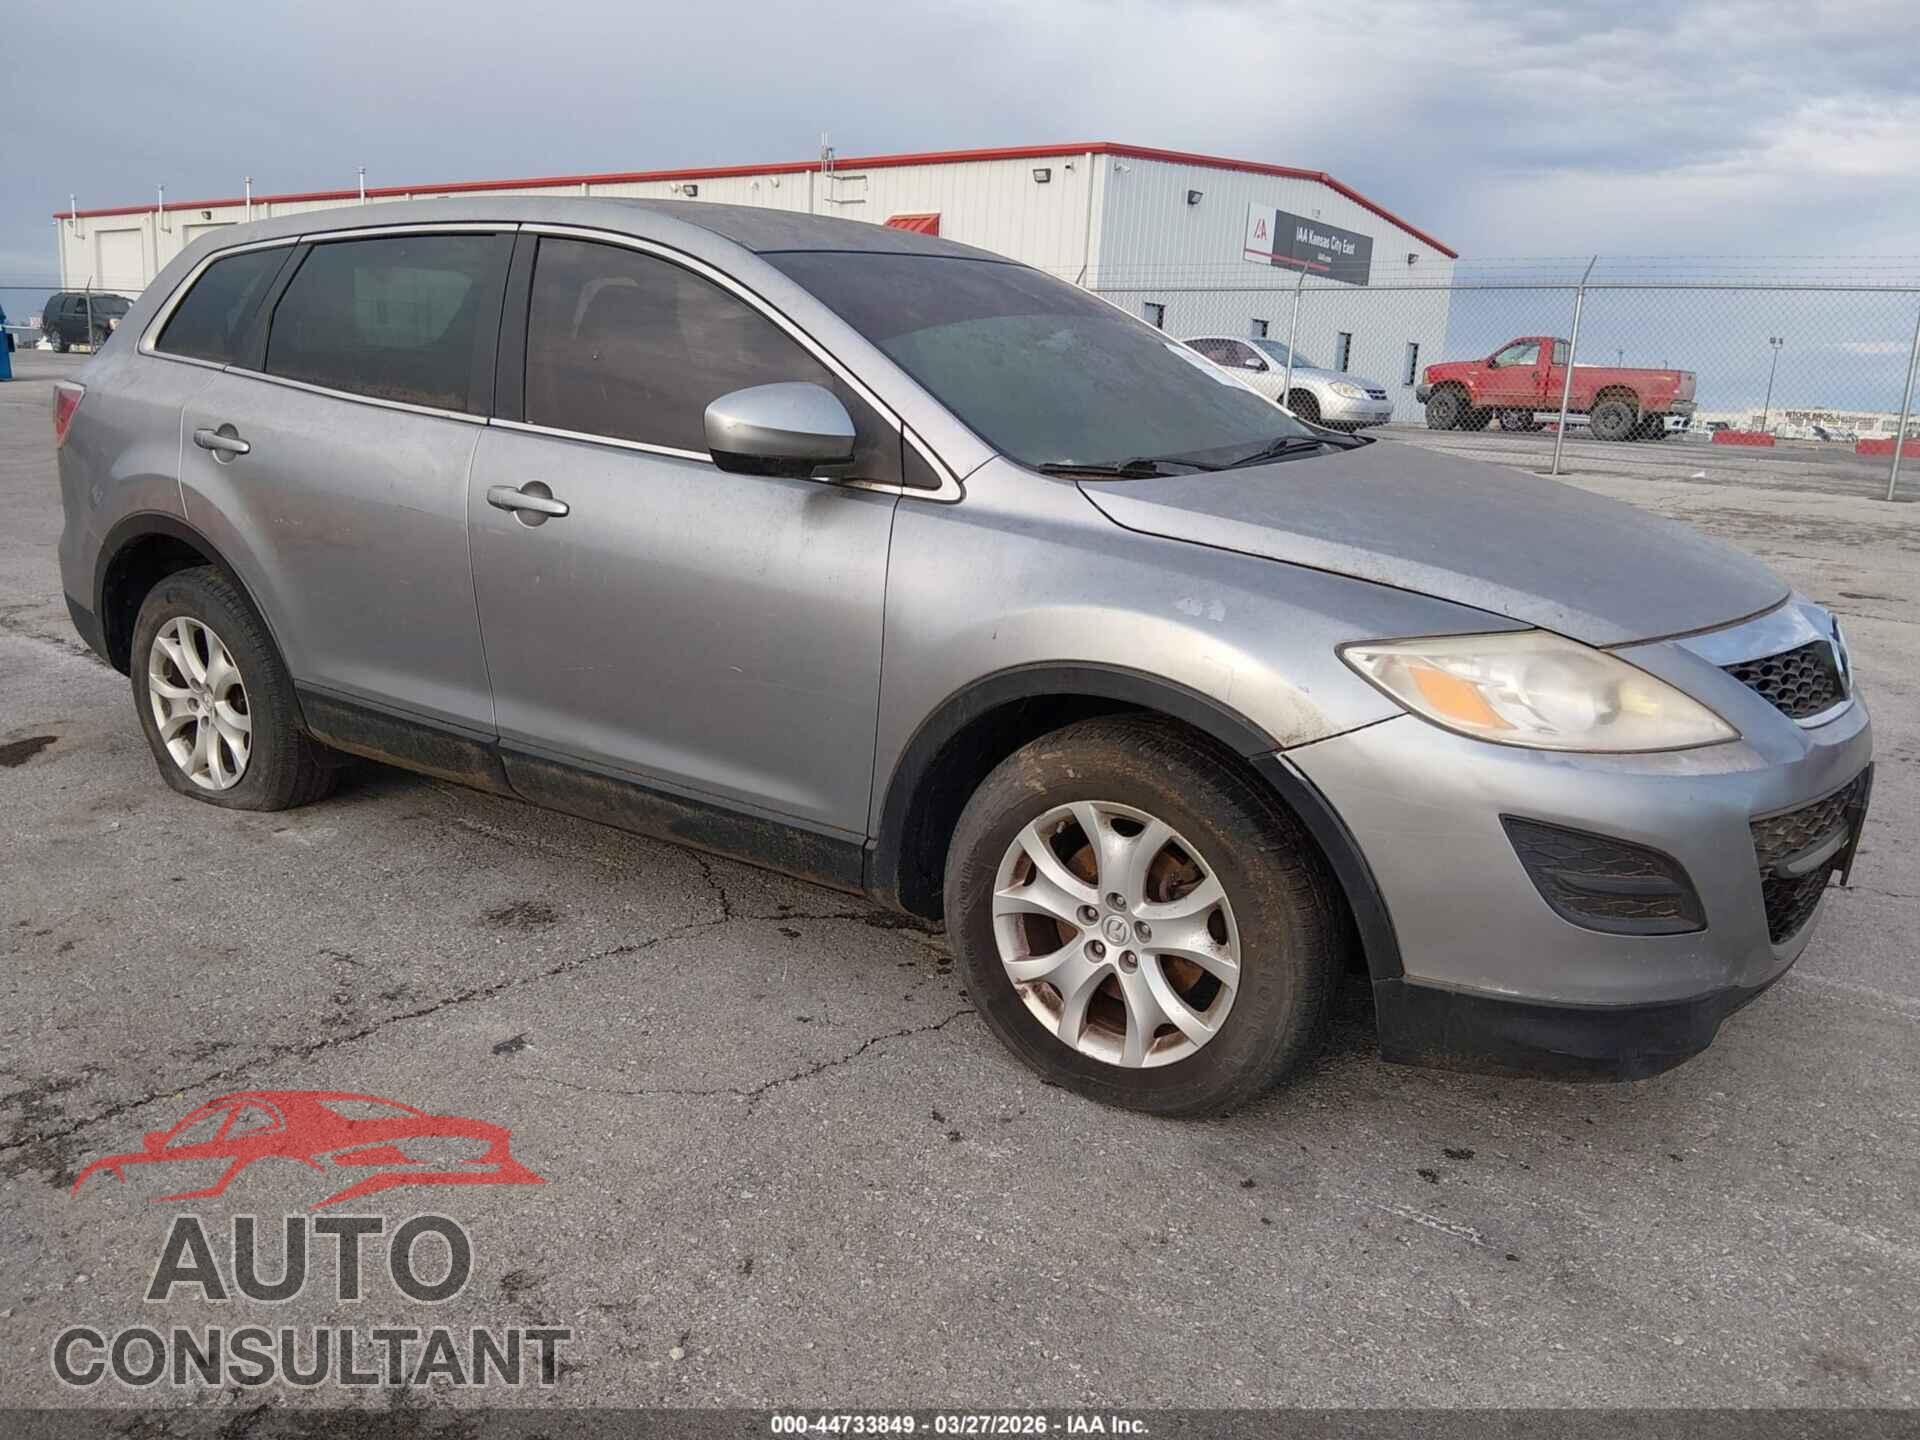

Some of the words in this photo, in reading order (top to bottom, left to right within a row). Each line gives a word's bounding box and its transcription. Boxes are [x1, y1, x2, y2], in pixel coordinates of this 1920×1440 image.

[1296, 226, 1308, 242] IAA
[1308, 229, 1330, 249] Kansas
[1331, 235, 1342, 256] City
[1343, 239, 1355, 255] East
